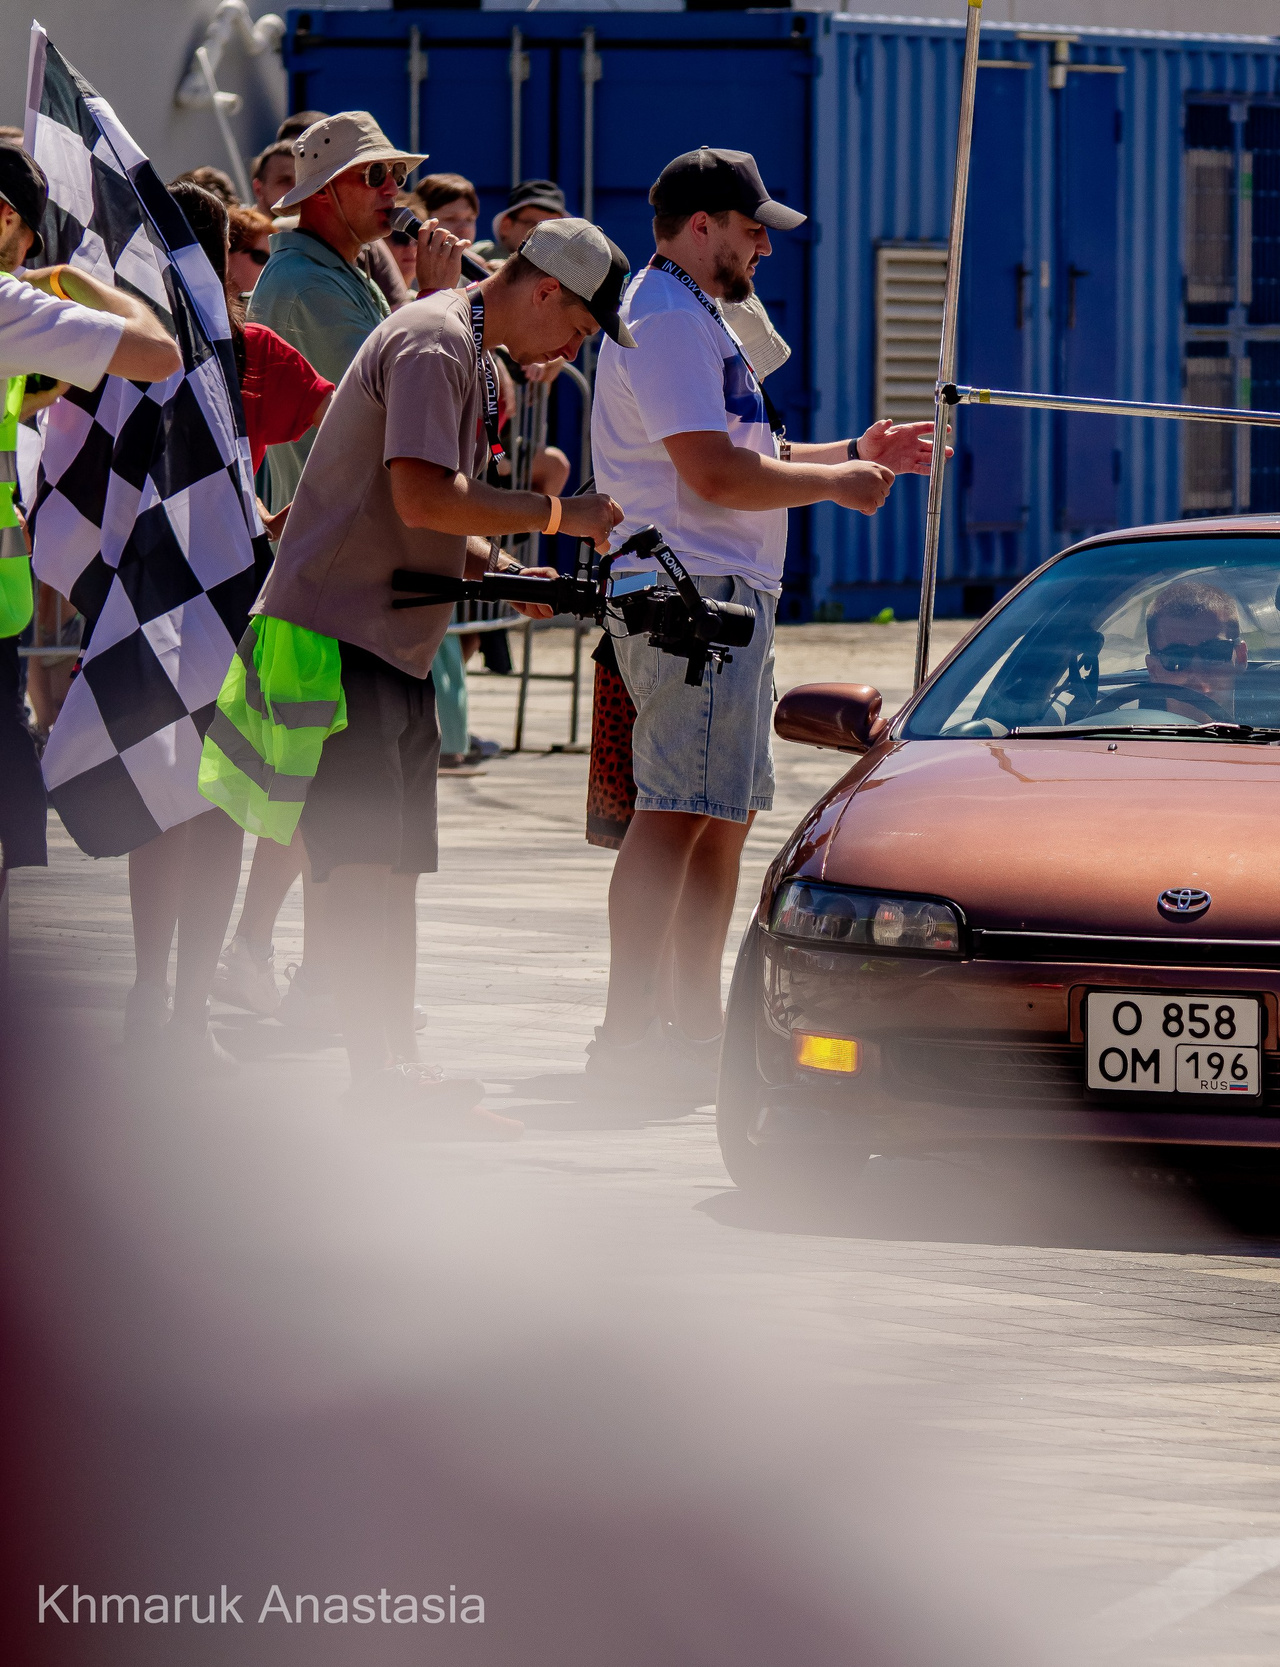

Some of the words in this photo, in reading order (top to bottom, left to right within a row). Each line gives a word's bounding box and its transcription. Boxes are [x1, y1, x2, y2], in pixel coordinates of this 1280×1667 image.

[661, 259, 677, 273] IN
[674, 268, 700, 293] LOW
[697, 292, 714, 312] WE
[471, 305, 484, 320] IN
[487, 401, 498, 415] IN
[660, 550, 687, 582] RONIN
[1162, 1002, 1237, 1040] 858
[1185, 1051, 1249, 1081] 196
[1200, 1080, 1228, 1091] RUS
